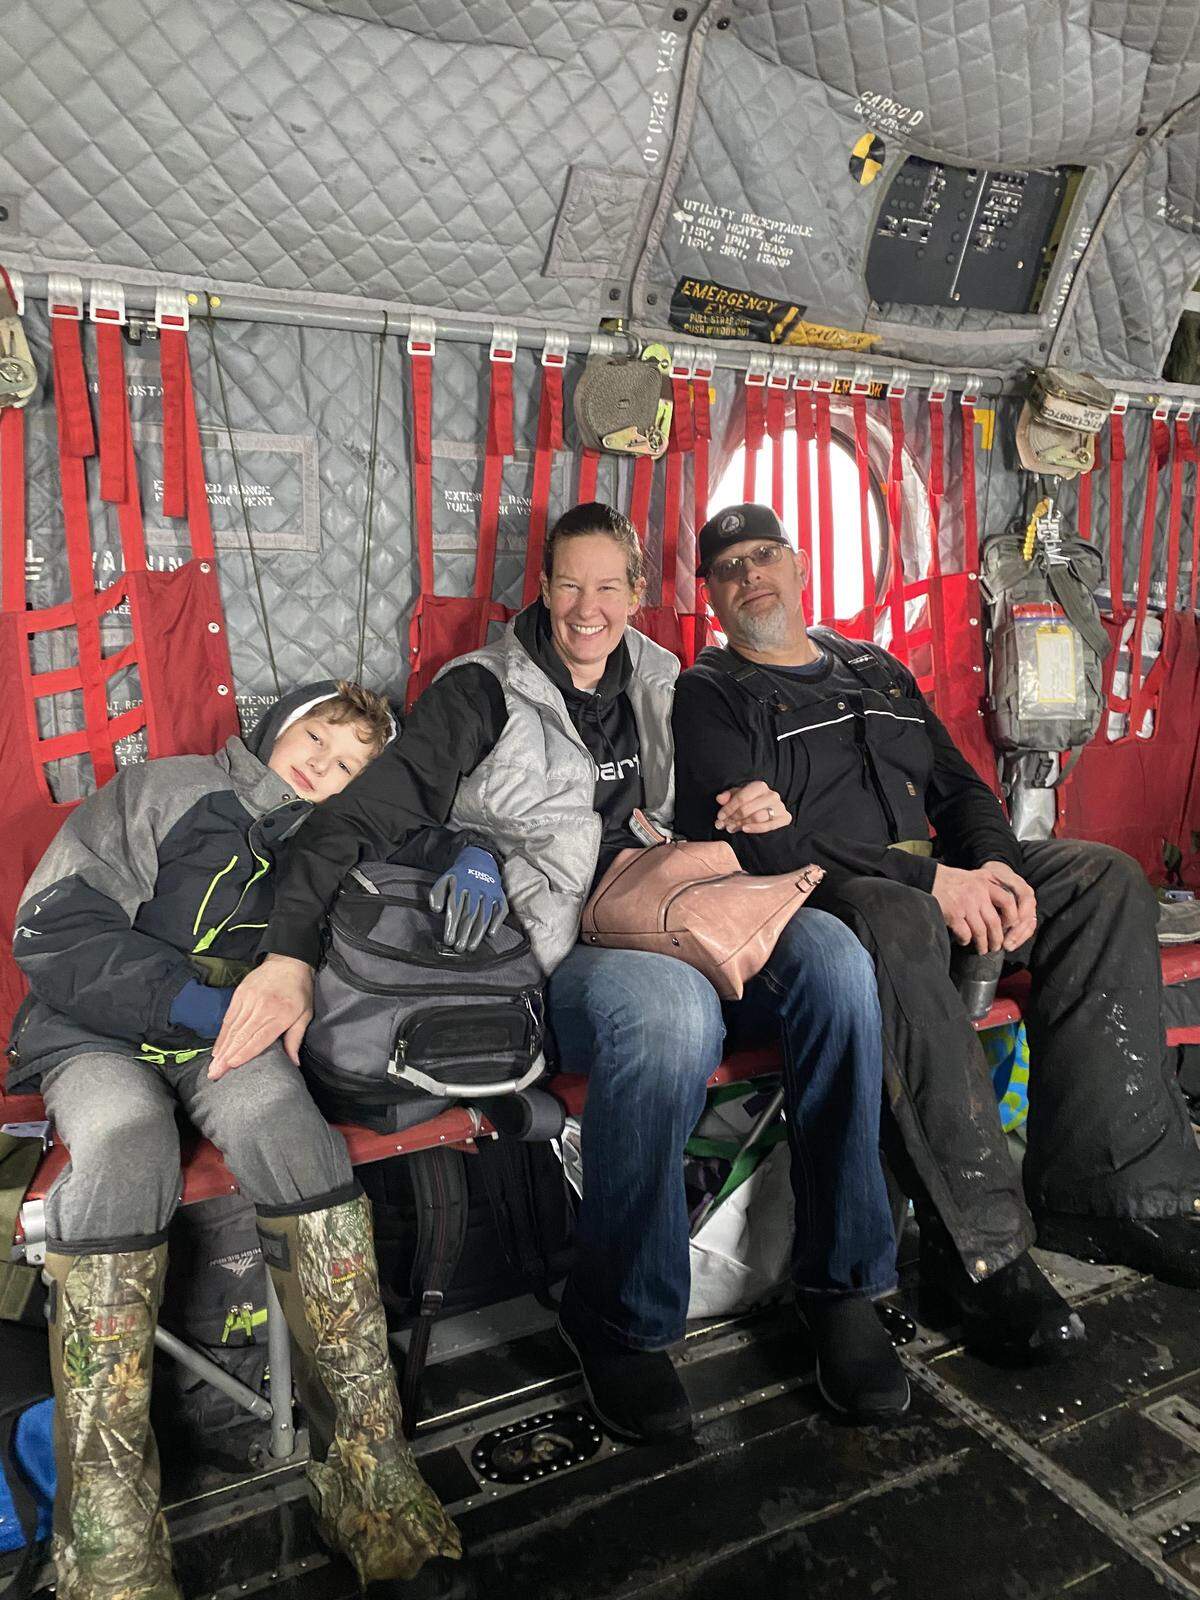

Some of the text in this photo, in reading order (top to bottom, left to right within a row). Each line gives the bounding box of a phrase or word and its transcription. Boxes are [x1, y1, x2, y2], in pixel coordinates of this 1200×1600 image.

[656, 30, 678, 73] STA
[861, 90, 924, 126] CARGO D
[683, 199, 813, 238] UTILITY RECEPTACLE
[697, 215, 786, 245] 400 HERTZ AC
[681, 280, 778, 314] EMERGENCY
[228, 483, 271, 496] RANGE
[243, 496, 275, 507] VENT
[467, 868, 496, 884] KINCO
